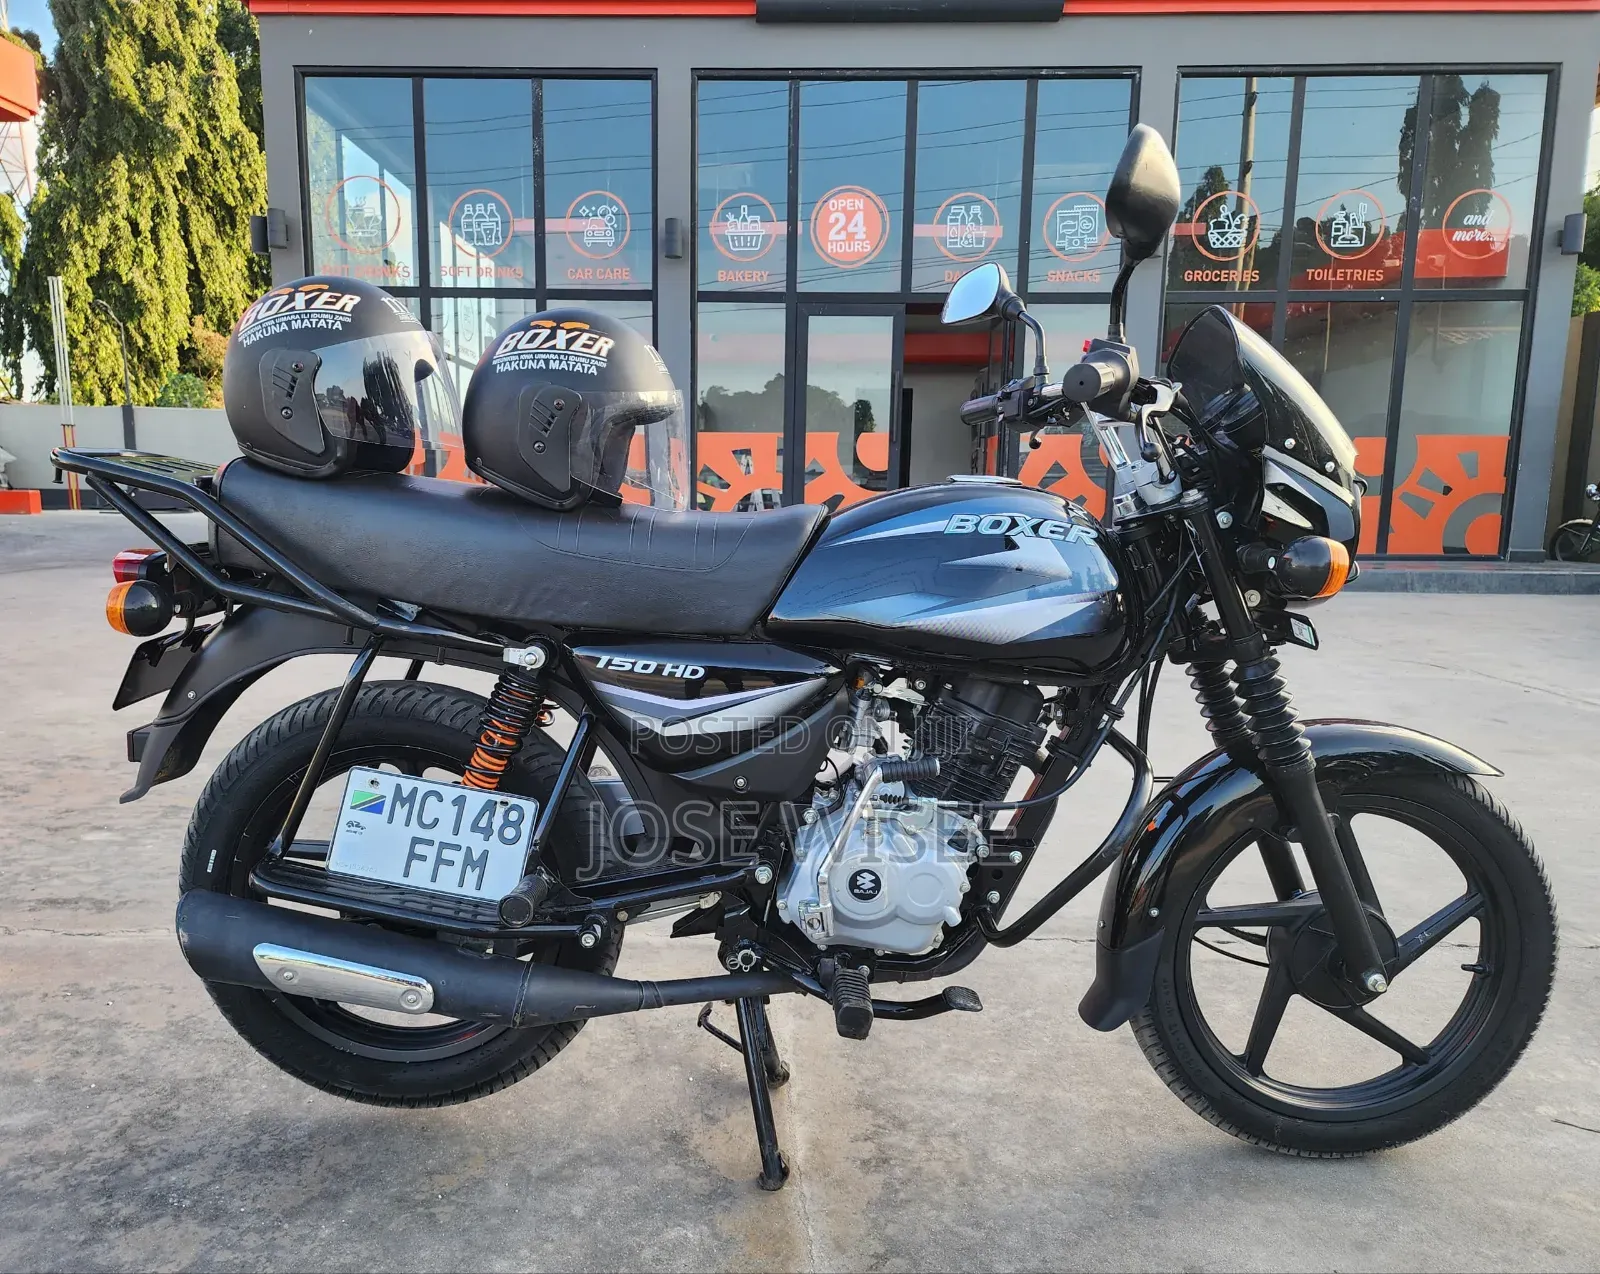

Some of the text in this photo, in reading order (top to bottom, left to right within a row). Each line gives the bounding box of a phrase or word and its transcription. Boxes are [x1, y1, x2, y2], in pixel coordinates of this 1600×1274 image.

[828, 198, 865, 211] OPEN
[1463, 209, 1494, 226] and
[828, 211, 867, 241] 24
[827, 240, 871, 253] HOURS
[354, 264, 411, 279] DRINKS
[440, 265, 524, 279] SOFT DRINKS
[567, 267, 631, 280] CAR CARE
[717, 270, 769, 283] BAKERY
[1046, 270, 1101, 283] SNACKS
[1184, 269, 1260, 283] GROCERIES
[1306, 268, 1384, 282] TOILETRIES
[238, 291, 362, 333] BOXER
[243, 323, 289, 347] HAKUNA
[292, 319, 343, 331] MATATA
[495, 328, 616, 358] BOXER
[496, 359, 546, 374] HAKUNA
[549, 359, 598, 376] MATATA
[943, 513, 1099, 546] BOXER
[596, 655, 705, 680] 150 HD
[402, 836, 490, 892] FFM
